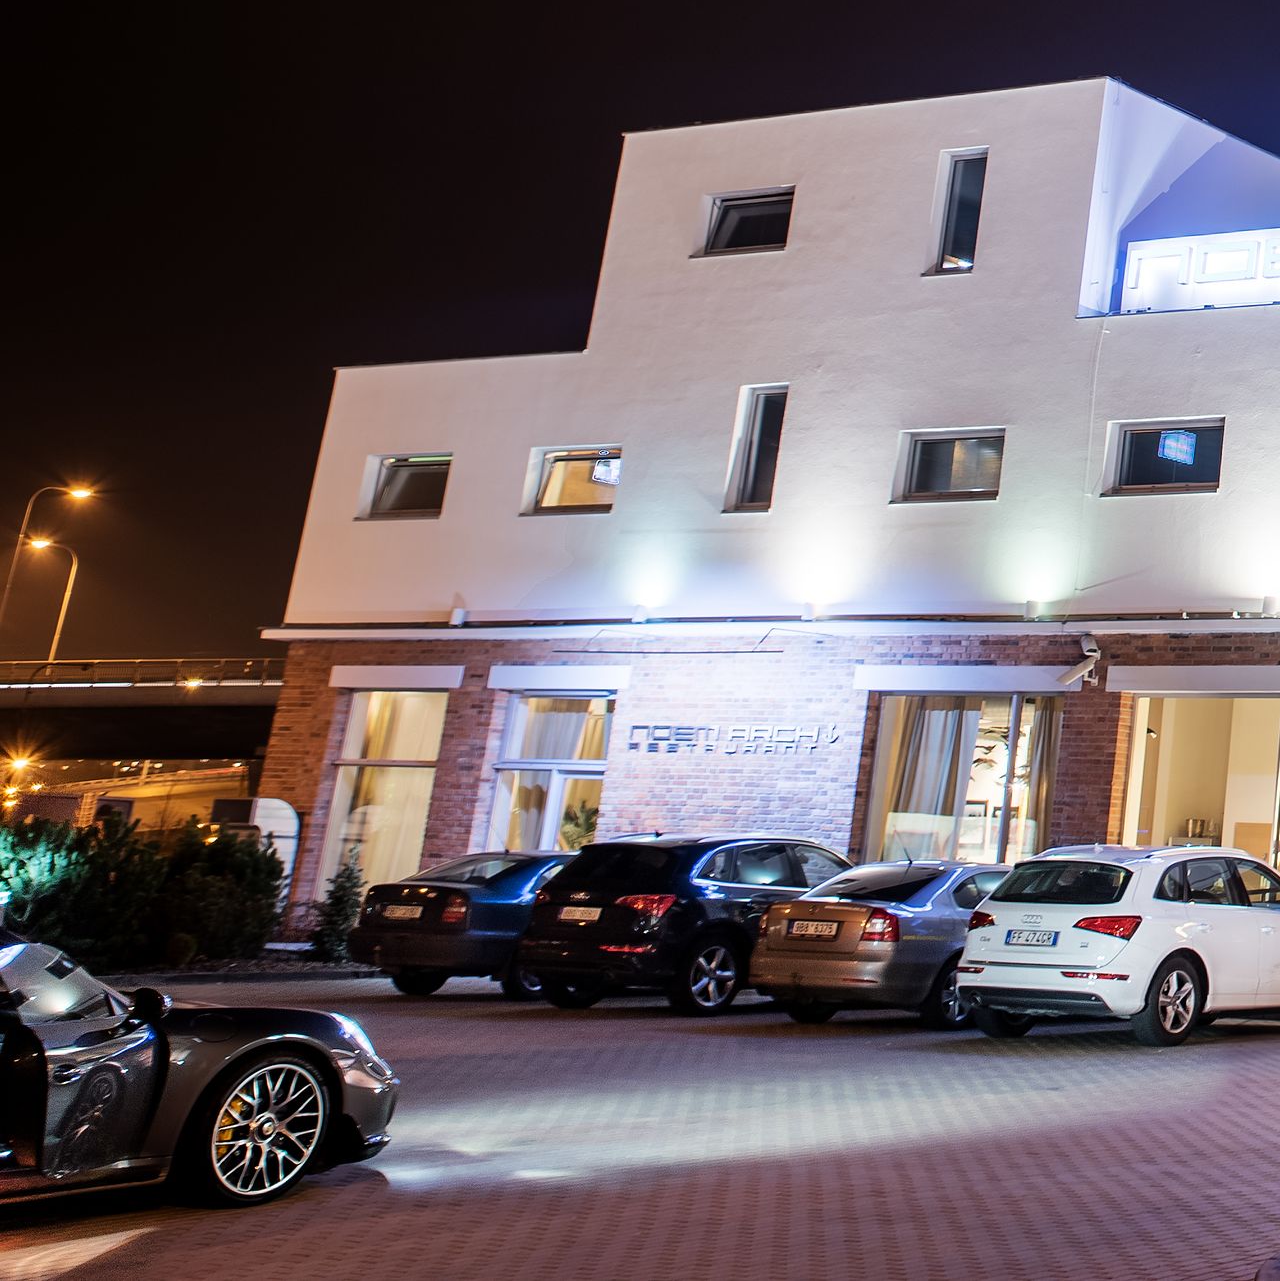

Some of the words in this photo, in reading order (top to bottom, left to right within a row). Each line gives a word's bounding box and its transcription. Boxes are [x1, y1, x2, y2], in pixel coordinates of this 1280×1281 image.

[629, 724, 720, 742] NOEM
[728, 724, 820, 743] ARCH
[628, 742, 818, 755] RESTAURANT
